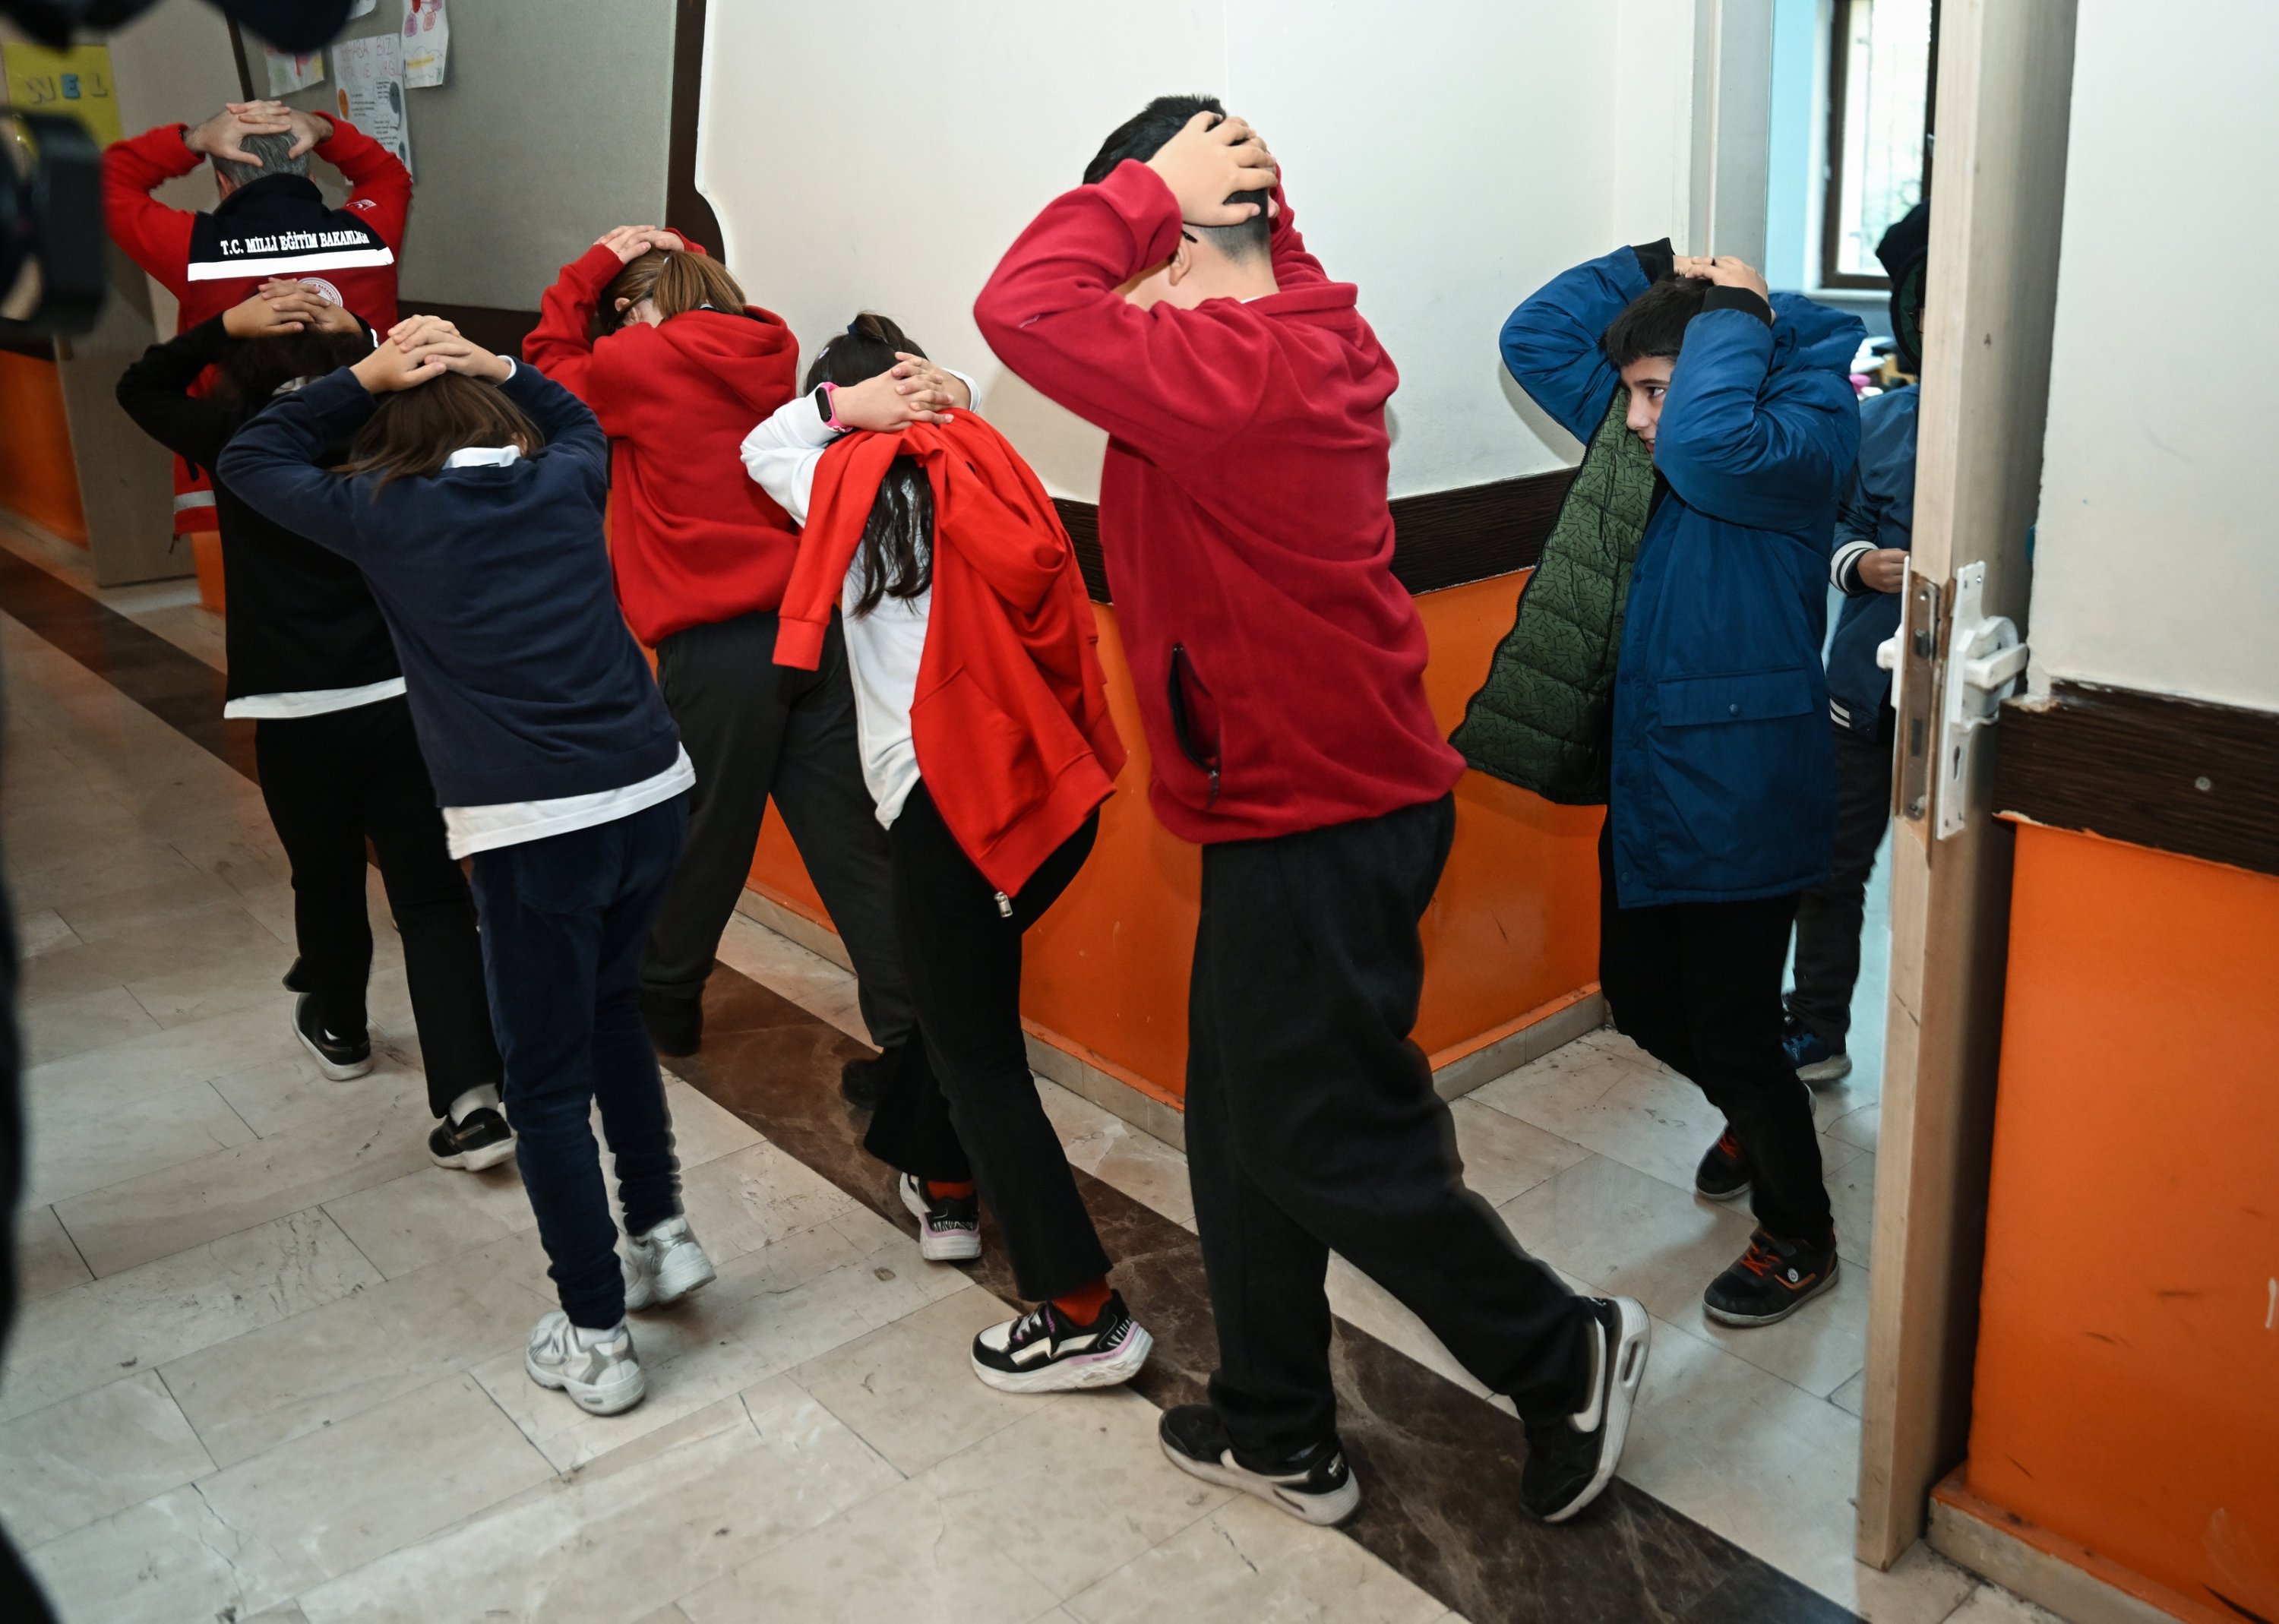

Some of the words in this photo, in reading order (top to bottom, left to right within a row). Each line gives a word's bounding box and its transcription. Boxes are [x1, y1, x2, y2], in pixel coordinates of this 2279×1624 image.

[24, 73, 108, 104] WEL
[220, 239, 244, 255] T.C.
[278, 230, 318, 251] EĞİTİM
